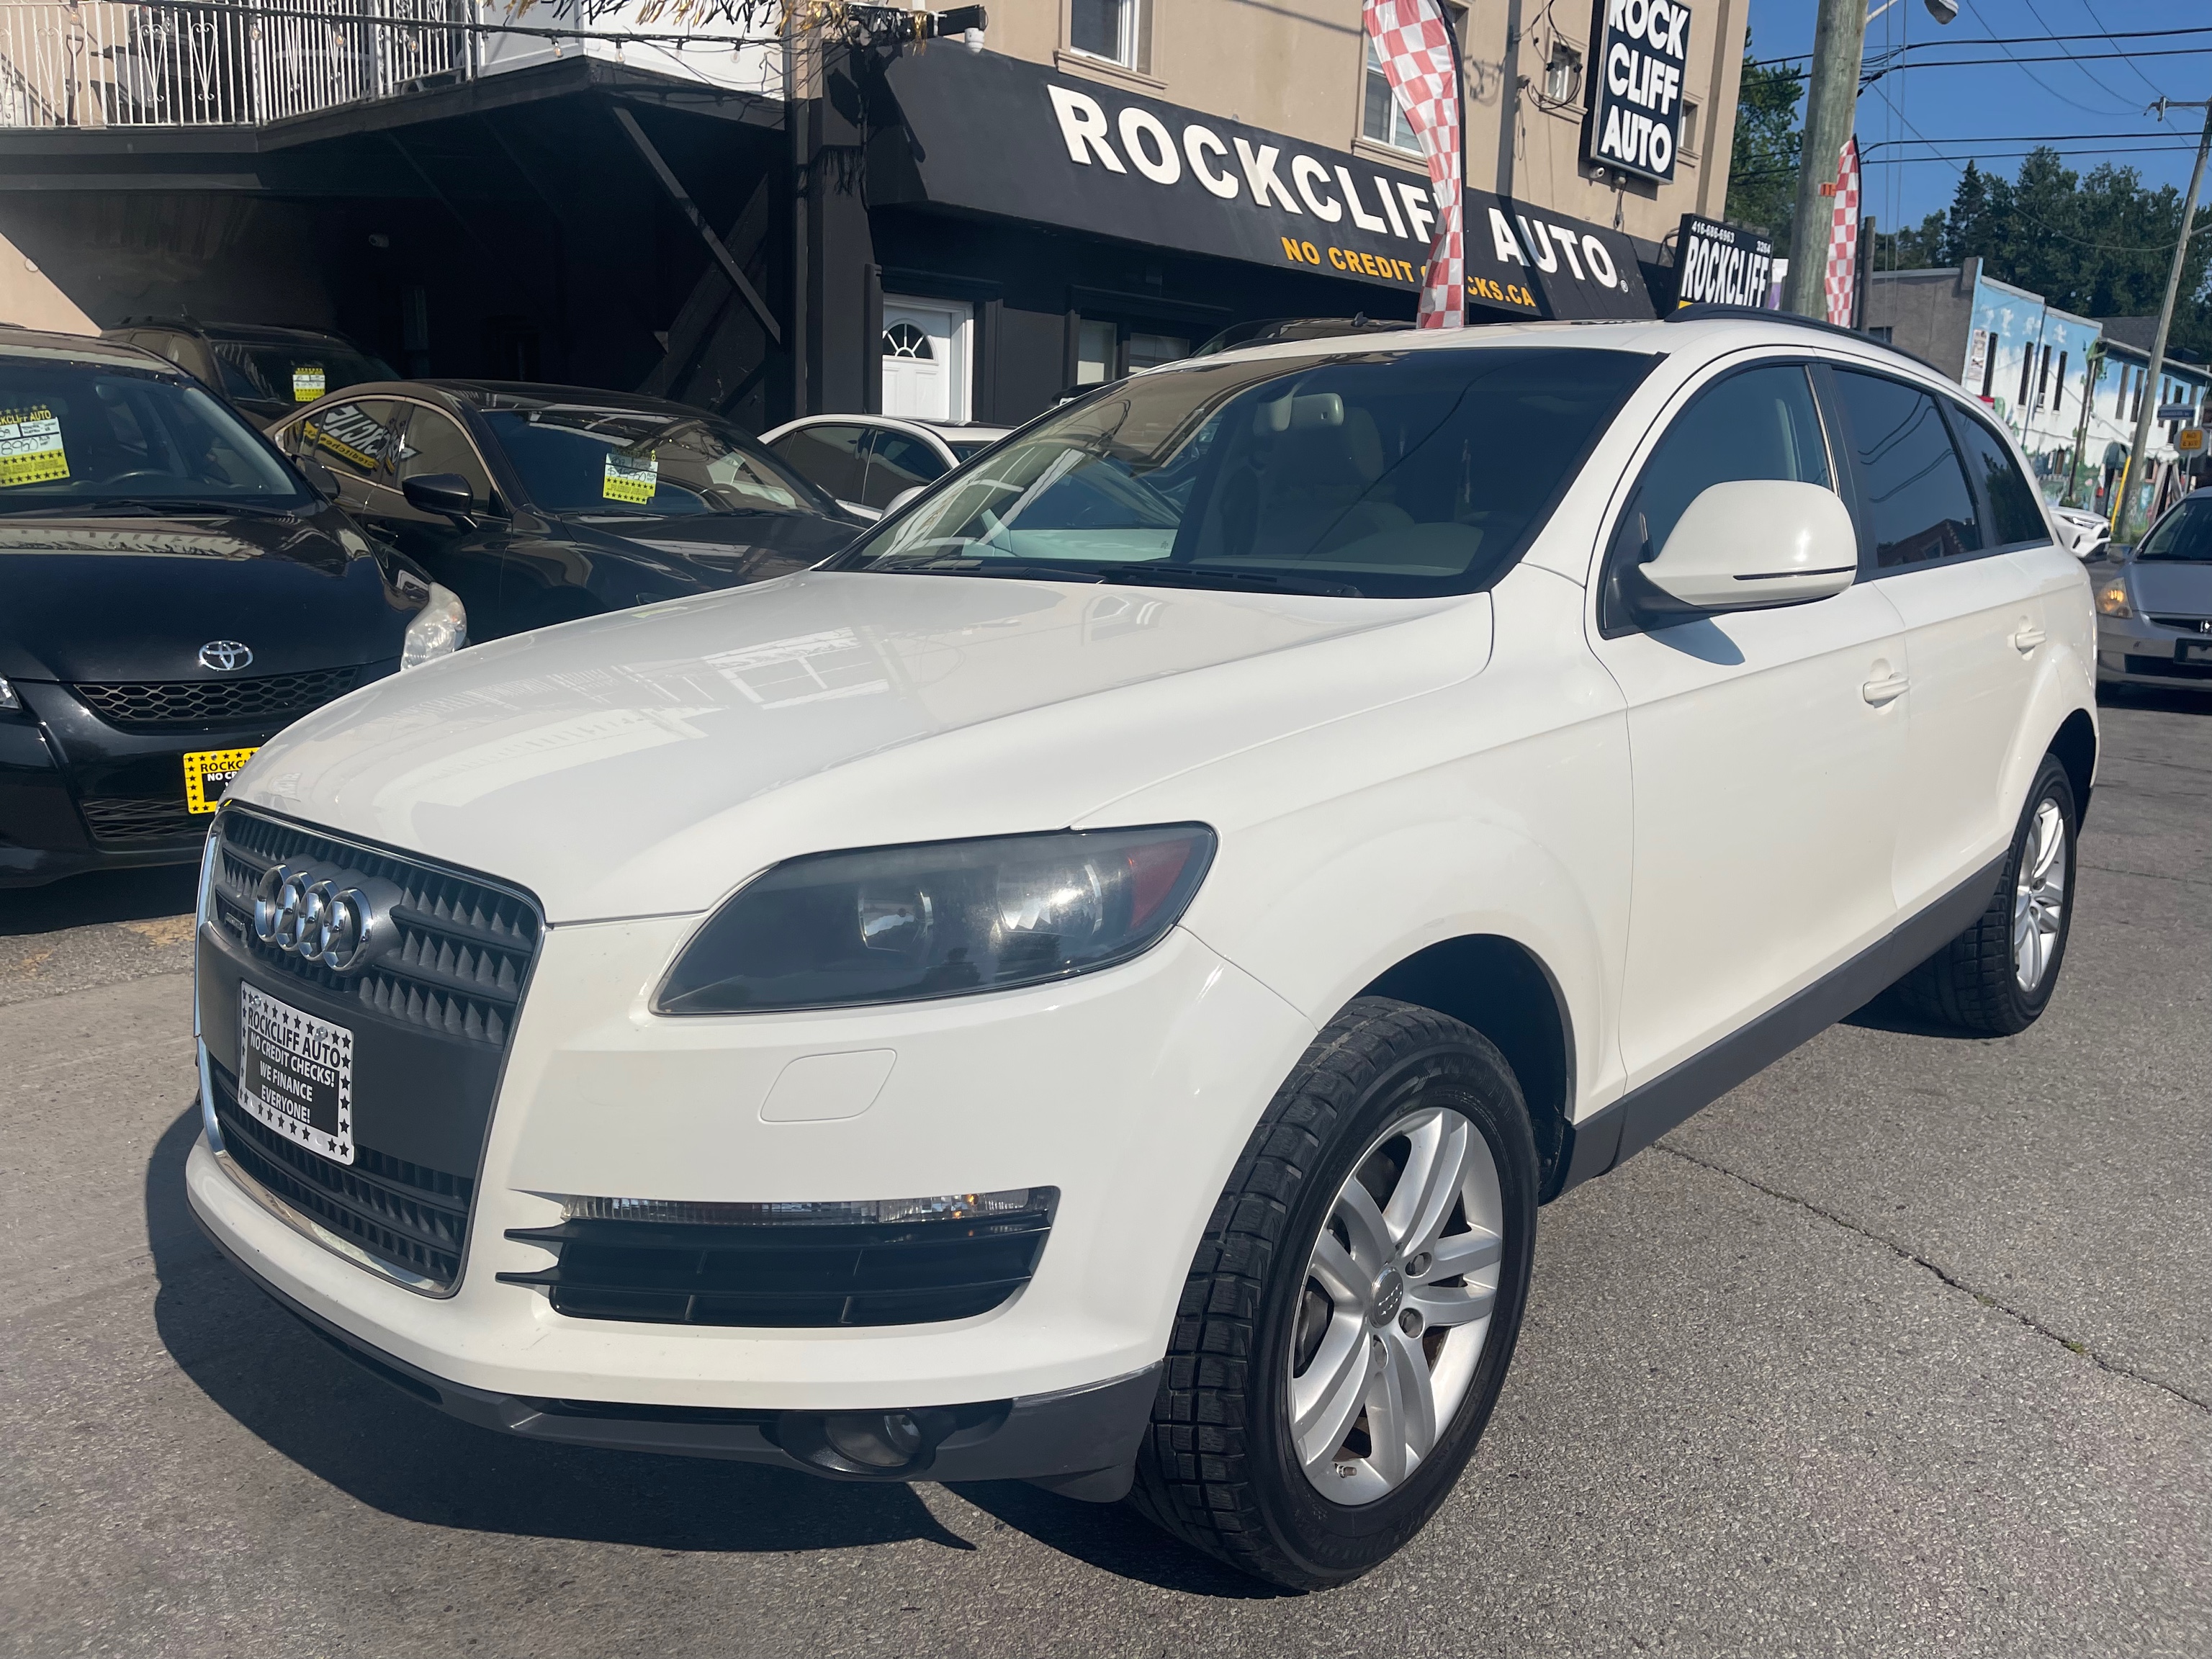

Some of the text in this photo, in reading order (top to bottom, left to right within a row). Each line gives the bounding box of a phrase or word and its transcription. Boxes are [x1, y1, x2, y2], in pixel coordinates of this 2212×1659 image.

[1609, 0, 1689, 60] ROCK
[1608, 42, 1681, 115] CLIFF
[1047, 84, 1442, 244] ROCKCLIF
[1600, 104, 1673, 174] AUTO
[1281, 237, 1321, 265] NO
[1328, 246, 1415, 282] CREDIT
[1681, 235, 1770, 308] ROCKCLIFF
[30, 410, 51, 421] AUTO
[207, 773, 223, 782] NO
[248, 1006, 341, 1068] ROCKCLIFF AUTO
[250, 1031, 335, 1088] NO CREDIT CHECKS!
[260, 1060, 313, 1102] WE FINANCE
[261, 1084, 310, 1124] EVERYONE!
